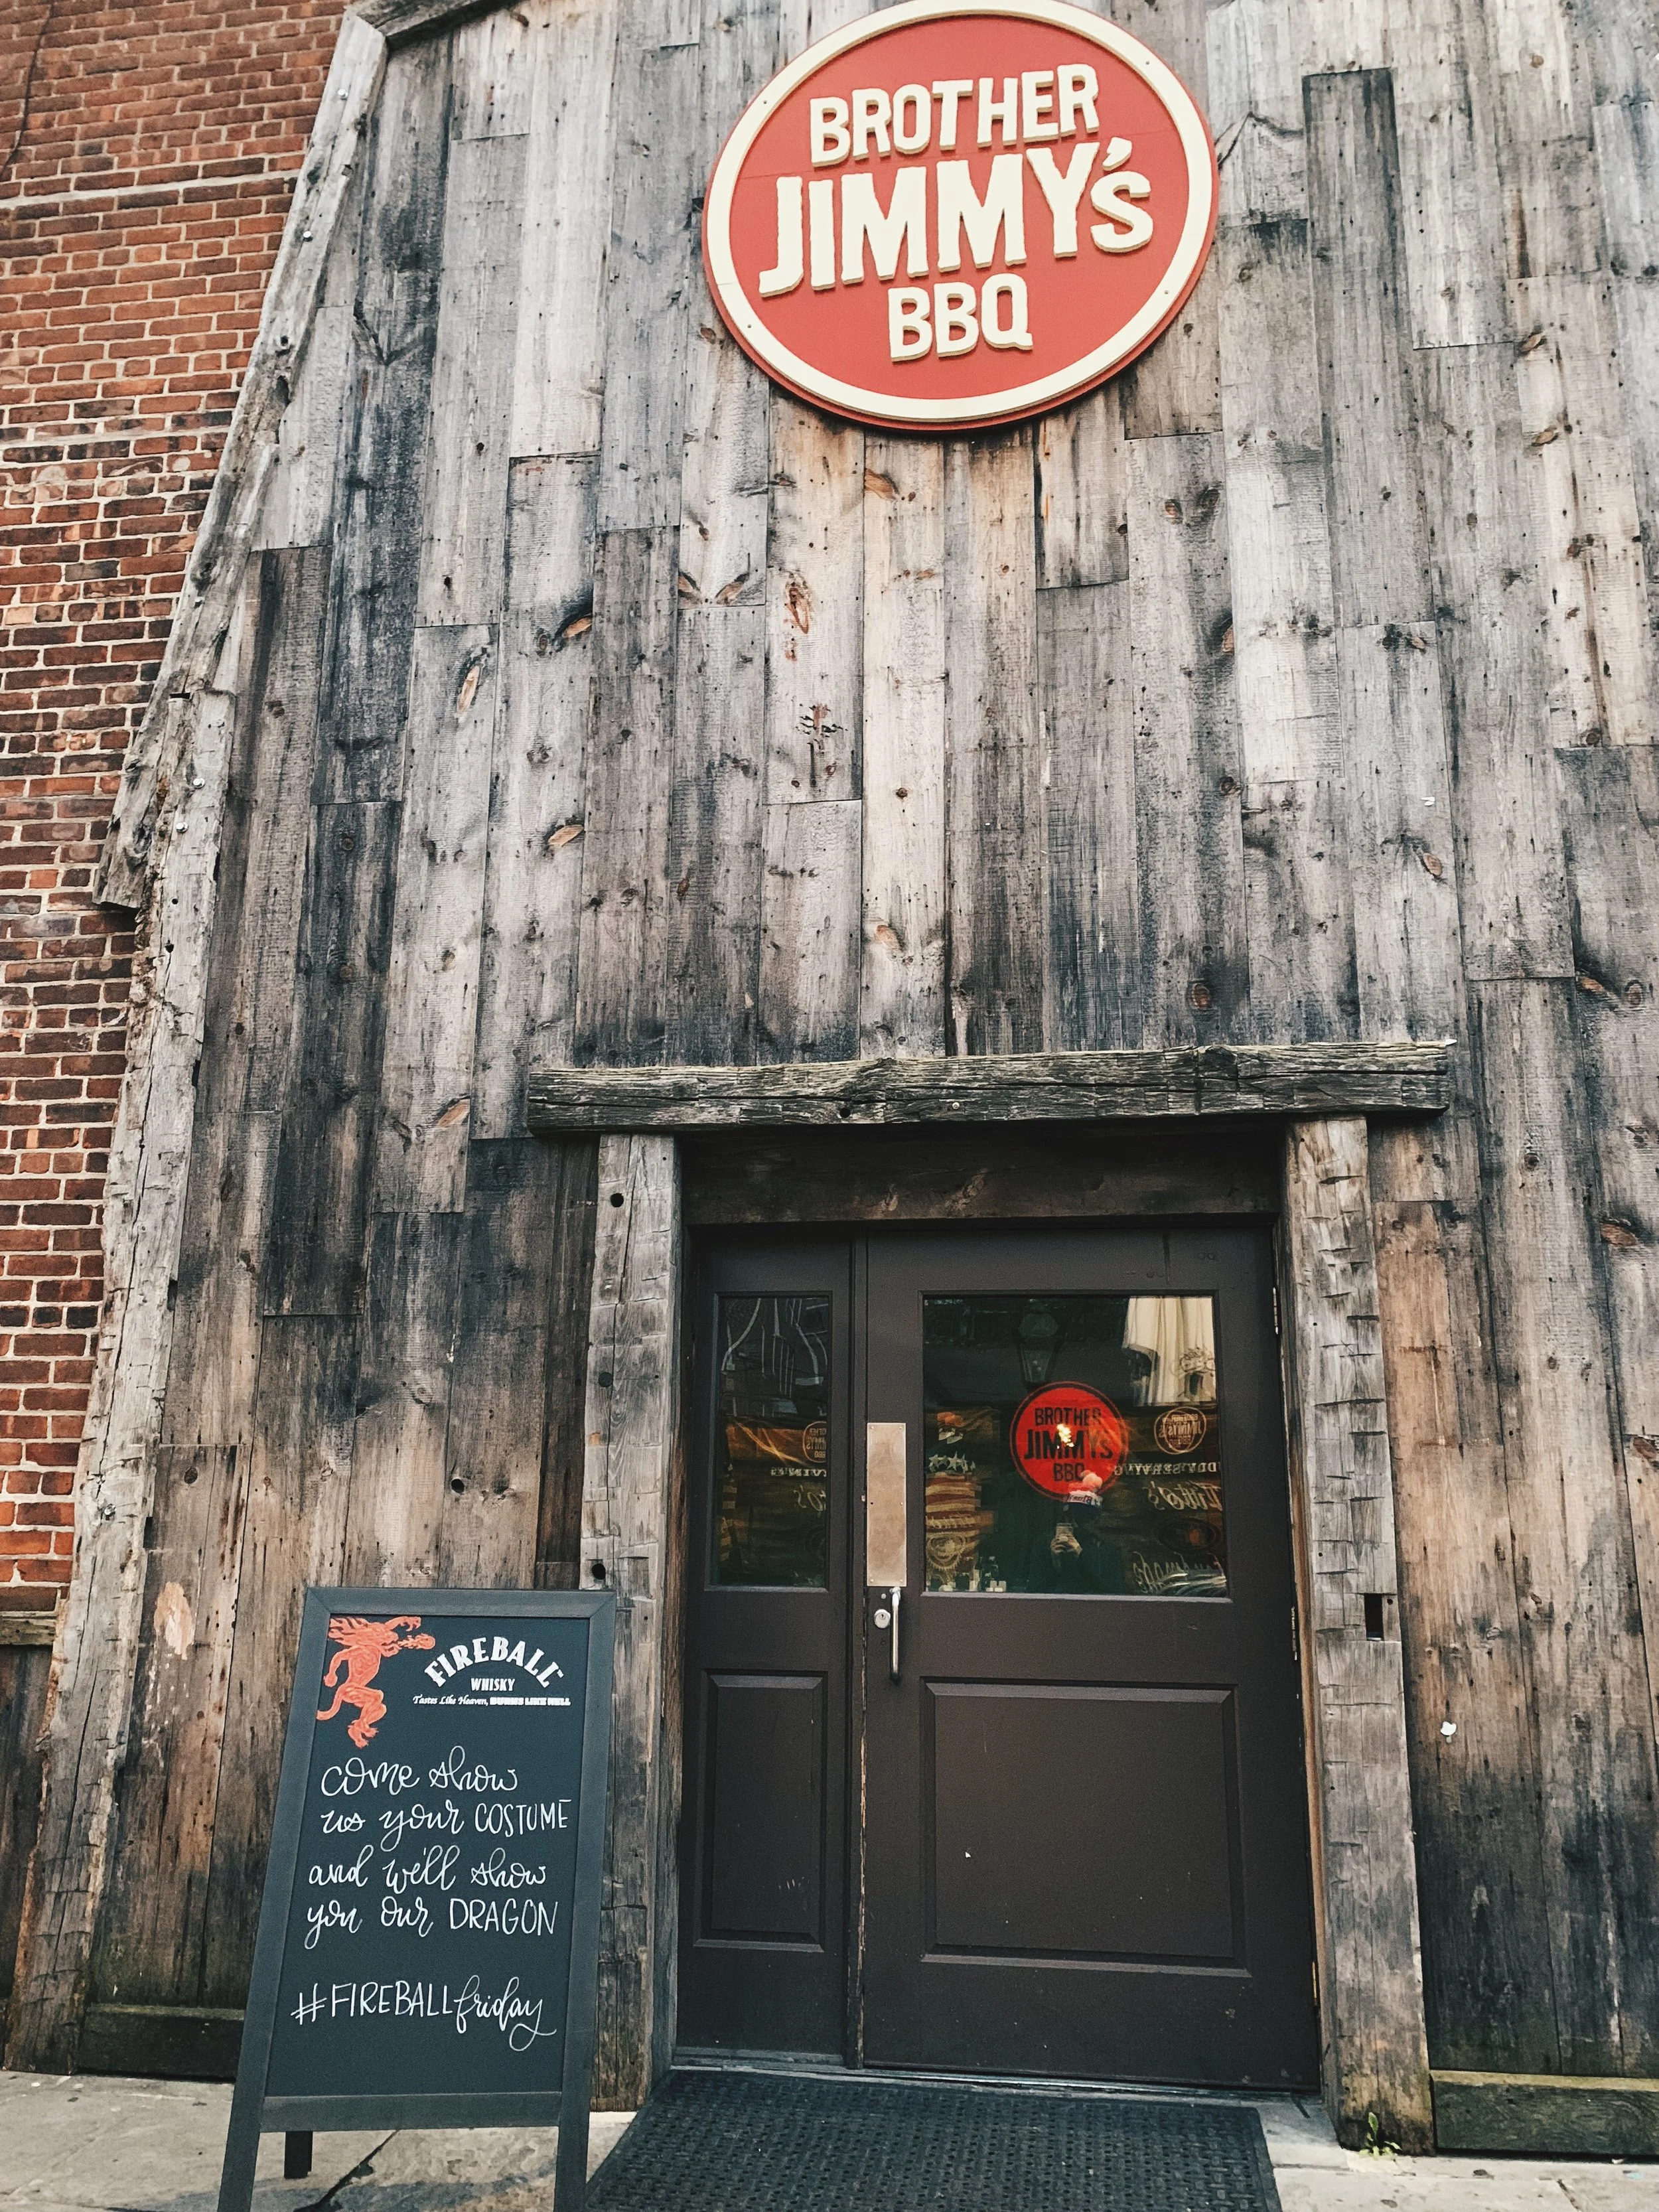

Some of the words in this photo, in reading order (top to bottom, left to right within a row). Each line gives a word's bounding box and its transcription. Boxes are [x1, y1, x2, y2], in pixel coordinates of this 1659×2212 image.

[809, 63, 1100, 167] BROTHER
[888, 273, 1033, 362] BBQ
[1034, 1407, 1102, 1426] BROTHER
[413, 1694, 438, 1704] Tastes
[439, 1694, 456, 1704] Like
[458, 1694, 488, 1706] Heaven,
[471, 1678, 515, 1691] WHISKY
[321, 1757, 420, 1796] come
[429, 1745, 518, 1792] show
[321, 1810, 366, 1834] us
[379, 1799, 465, 1853] your
[475, 1799, 571, 1837] COSTUME
[309, 1845, 374, 1887] and
[381, 1843, 460, 1894] we'll
[470, 1848, 545, 1888] show
[305, 1900, 362, 1949] you
[381, 1896, 433, 1937] our
[450, 1898, 558, 1935] DRAGON
